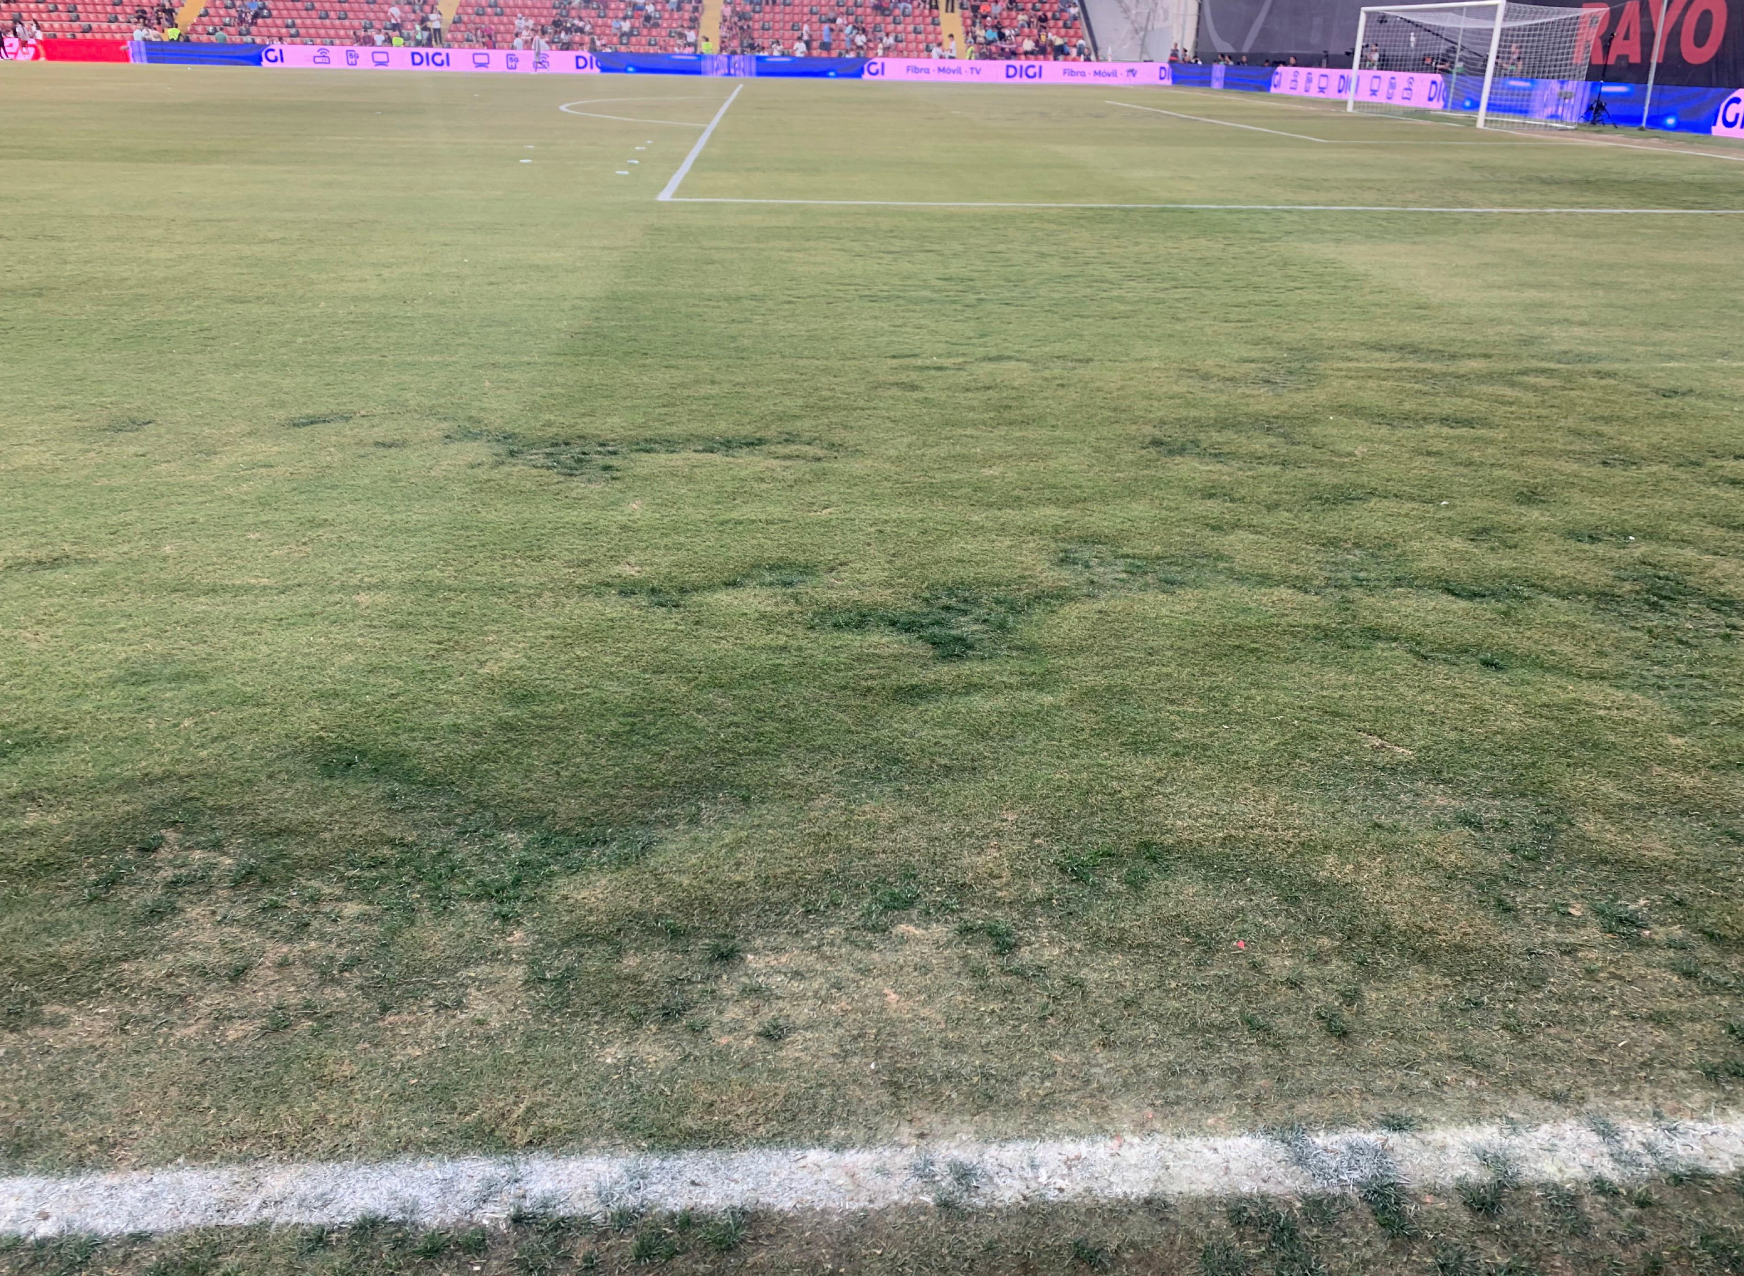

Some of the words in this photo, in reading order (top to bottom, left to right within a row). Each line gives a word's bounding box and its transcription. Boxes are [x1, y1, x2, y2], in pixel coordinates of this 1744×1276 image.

[1573, 0, 1728, 64] RAYO
[411, 52, 450, 67] DIGI
[906, 65, 930, 74] Fibra
[969, 67, 982, 75] TV
[1005, 64, 1043, 79] DIGI
[1062, 68, 1086, 77] Fibra
